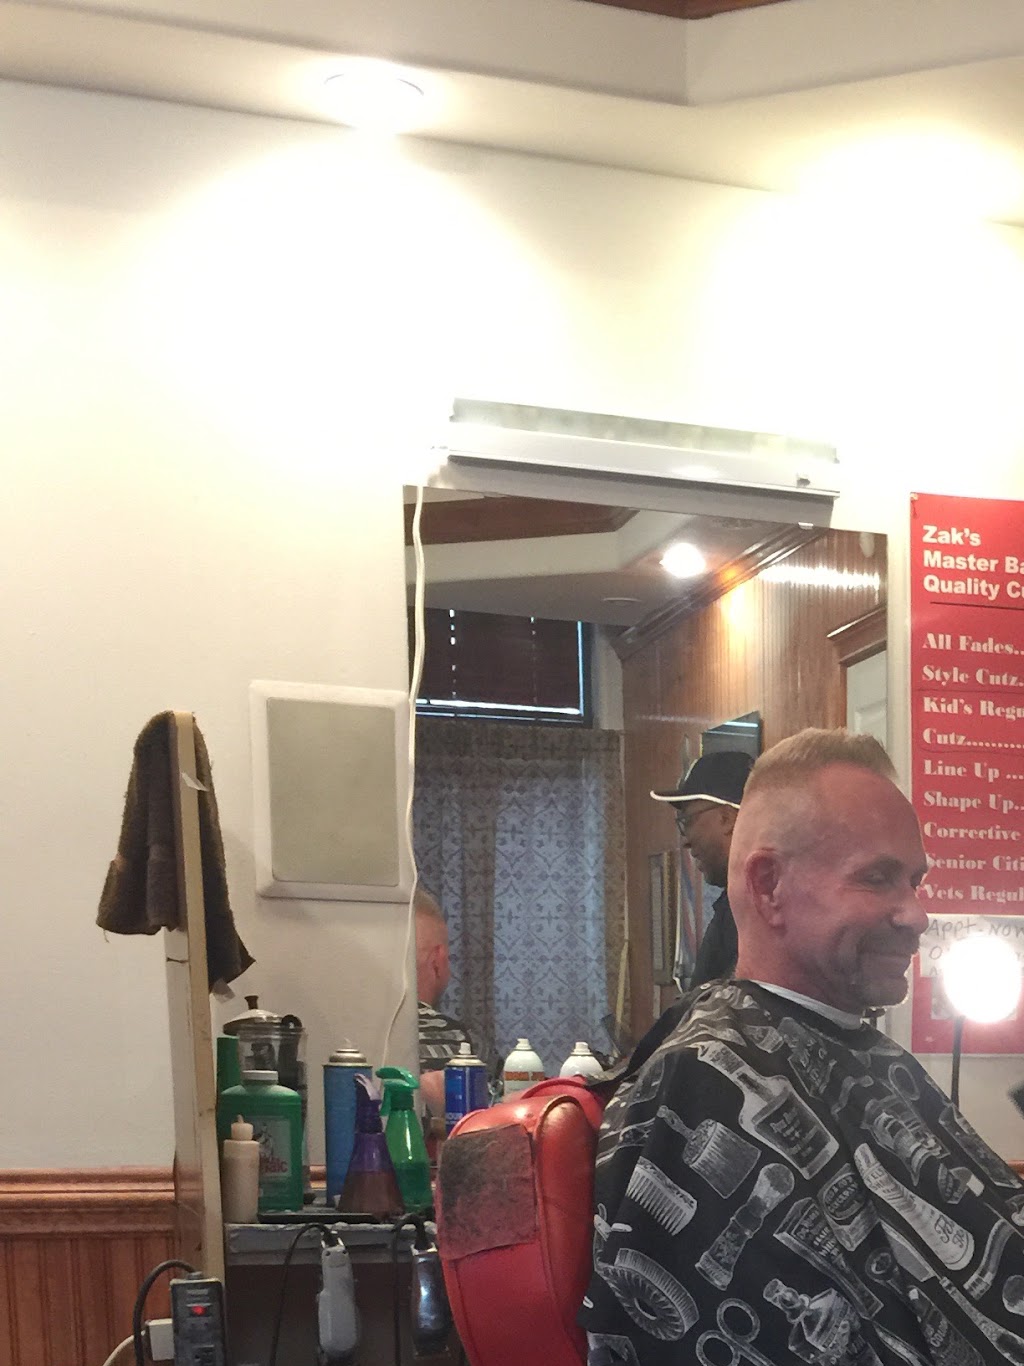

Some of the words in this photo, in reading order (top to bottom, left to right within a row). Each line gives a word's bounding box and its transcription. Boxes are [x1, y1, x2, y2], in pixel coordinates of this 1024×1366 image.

[922, 525, 981, 546] Zak's
[923, 550, 999, 572] Master
[923, 574, 1000, 600] Quality
[922, 632, 951, 650] All
[922, 664, 969, 686] Style
[923, 696, 973, 715] Kid's
[924, 759, 967, 776] Line
[974, 762, 1000, 783] Up
[923, 791, 982, 812] Shape
[923, 822, 1020, 840] Corrective
[925, 853, 987, 869] Senior
[924, 884, 964, 899] Vets
